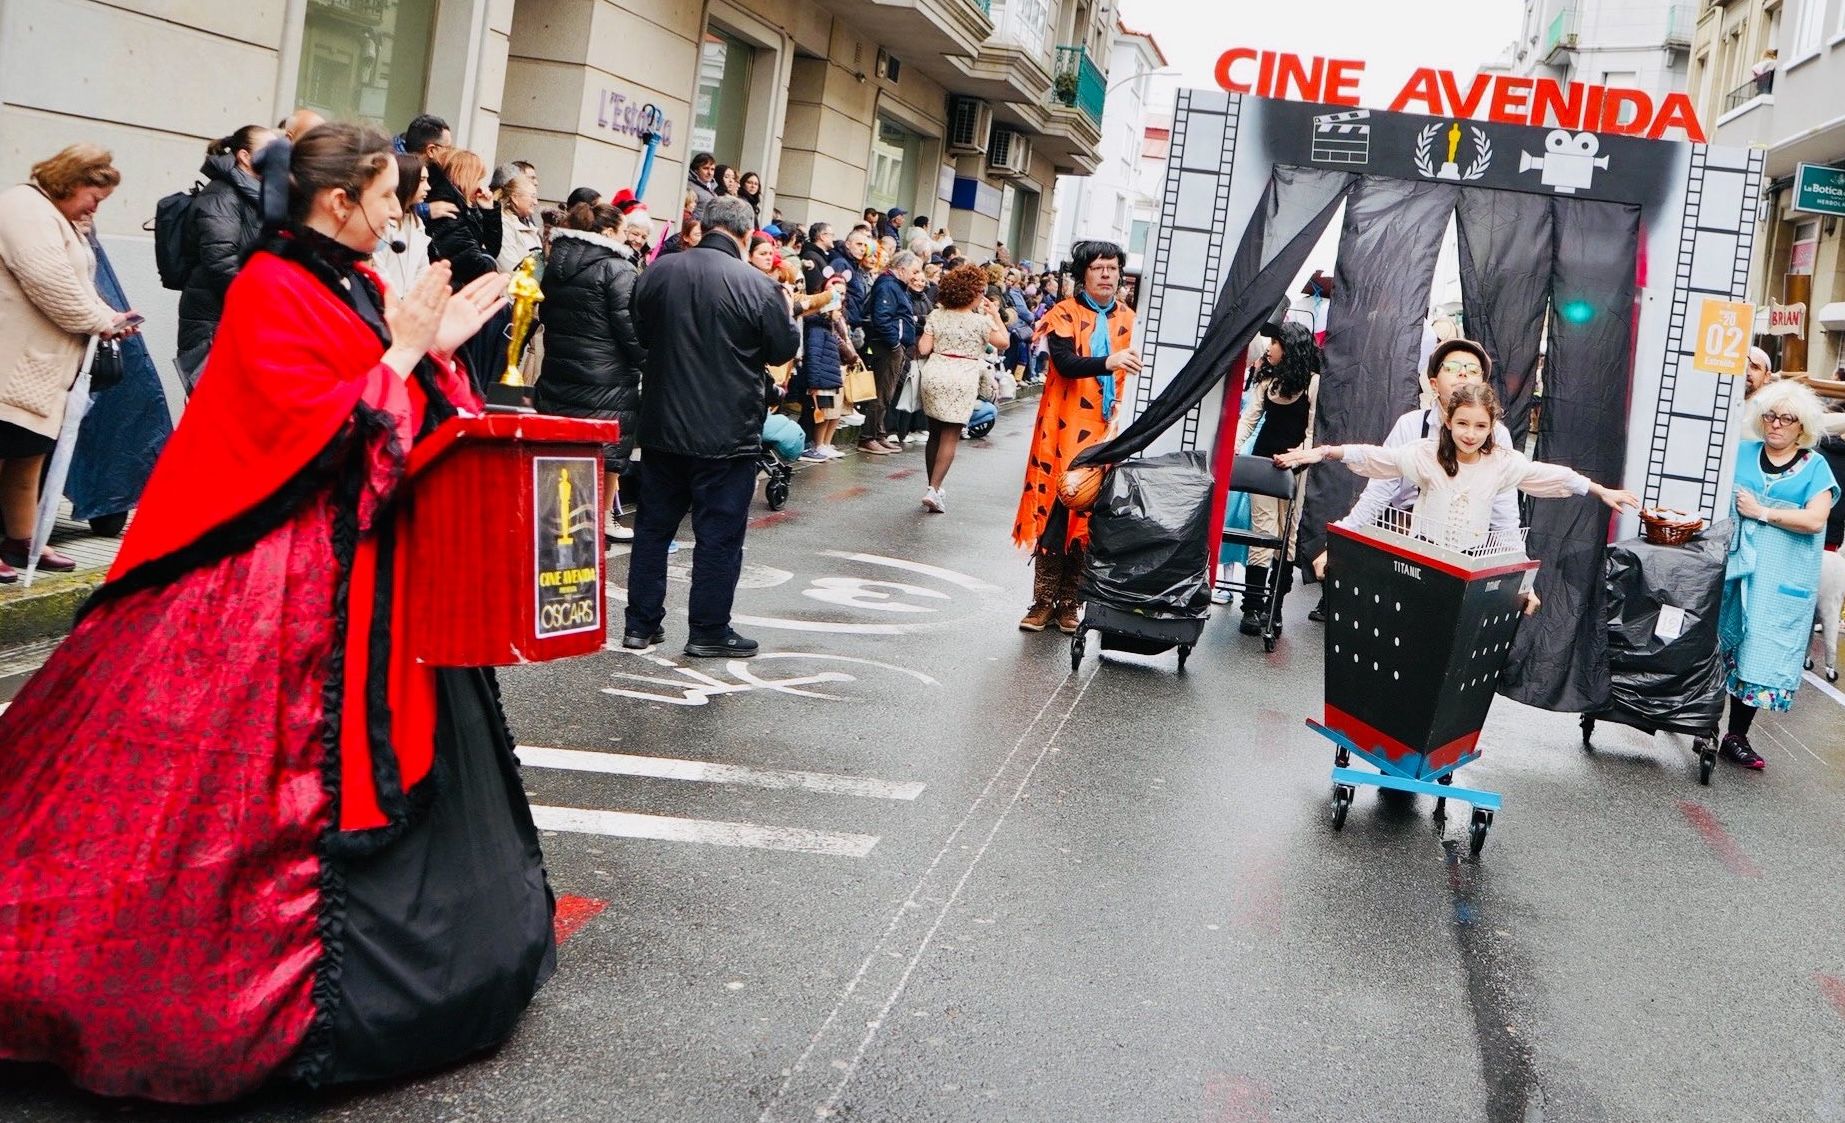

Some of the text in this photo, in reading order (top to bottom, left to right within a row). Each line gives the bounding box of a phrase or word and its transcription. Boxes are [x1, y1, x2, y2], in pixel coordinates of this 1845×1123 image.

[1214, 47, 1707, 144] CINE AVENIDA
[1812, 183, 1843, 196] Botica
[1771, 311, 1800, 326] BRIAN
[1705, 323, 1744, 358] 02
[540, 571, 562, 587] CINE
[1393, 560, 1421, 580] TITANIC
[541, 600, 594, 628] OSCARS
